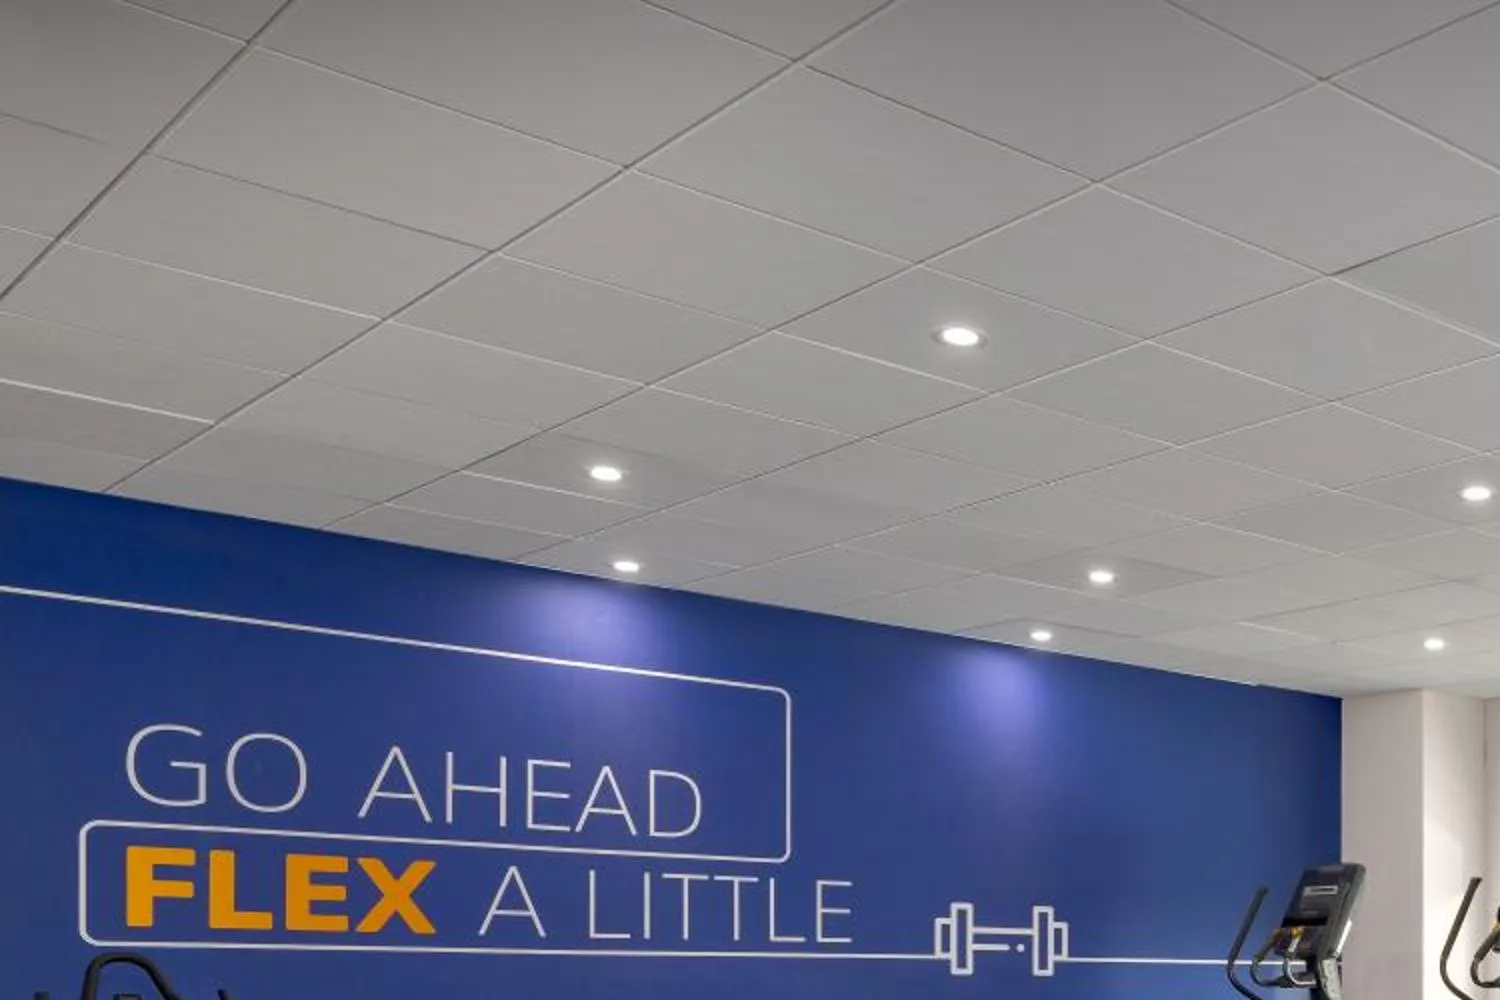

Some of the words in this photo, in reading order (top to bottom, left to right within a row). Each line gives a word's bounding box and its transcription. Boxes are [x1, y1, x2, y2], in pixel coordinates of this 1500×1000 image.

[125, 724, 308, 813] GO
[357, 745, 703, 838] AHEAD
[125, 845, 437, 935] FLEX
[478, 865, 546, 938] A
[588, 869, 854, 943] LITTLE
